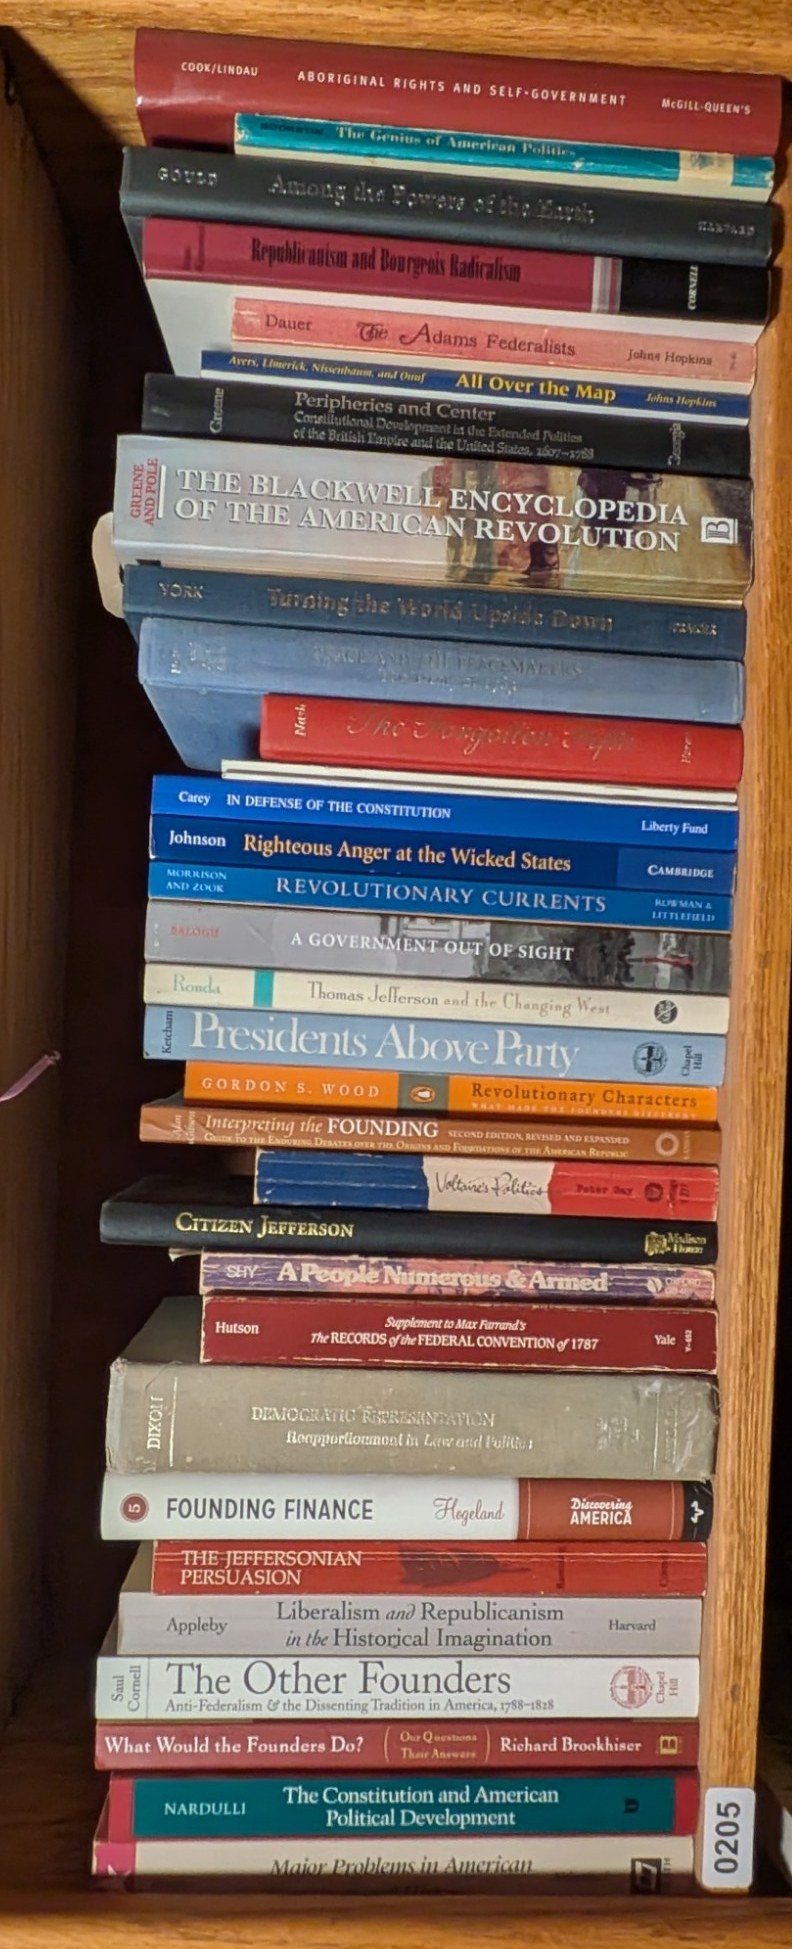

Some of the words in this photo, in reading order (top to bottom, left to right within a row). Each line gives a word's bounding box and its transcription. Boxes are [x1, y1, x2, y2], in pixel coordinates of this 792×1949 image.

[181, 62, 258, 76] COOK/LINDAU
[298, 70, 385, 88] ABORIGINAL
[393, 78, 445, 92] RIGHTS
[453, 83, 481, 96] AND
[490, 85, 626, 106] SELF-GOVERNMENT
[662, 98, 751, 115] McGILL-QUEEN'S
[251, 237, 347, 268] Republicanism
[352, 247, 376, 270] and
[380, 248, 445, 278] Bourgeois
[450, 255, 520, 282] Radicalism
[688, 265, 699, 310] CORNELL
[265, 314, 312, 331] Dauer
[357, 321, 388, 341] The
[399, 323, 477, 349] Adams
[487, 334, 576, 356] Federalists
[627, 349, 660, 362] Johns
[665, 351, 712, 366] Hopkins
[456, 373, 483, 388] All
[490, 376, 535, 392] Over
[539, 379, 569, 396] the
[575, 381, 616, 404] Map
[209, 388, 224, 433] Greene
[294, 391, 393, 414] Peripheries
[398, 401, 431, 416] and
[437, 404, 496, 421] Center
[146, 458, 158, 499] POLE
[130, 464, 144, 519] GREENE
[175, 469, 240, 494] THE
[248, 474, 441, 509] BLACKWELL
[450, 488, 689, 526] ENCYCLOPEDIA
[144, 499, 156, 526] AND
[175, 498, 216, 520] OF
[225, 501, 291, 526] THE
[299, 506, 464, 538] AMERICAN
[474, 519, 680, 552] REVOLUTION
[159, 582, 204, 599] YORK
[294, 703, 306, 736] Nash
[178, 791, 210, 805] Carey
[226, 794, 241, 806] IN
[245, 796, 303, 810] DEFENSE
[306, 799, 324, 811] OF
[327, 800, 353, 813] THE
[357, 802, 451, 819] CONSTITUTION
[641, 820, 680, 835] Liberty
[682, 823, 708, 835] Fund
[169, 830, 226, 847] Johnson
[244, 833, 333, 858] Righteous
[337, 841, 391, 863] Anger
[395, 846, 412, 861] at
[418, 844, 445, 863] the
[451, 847, 516, 868] Wicked
[521, 852, 572, 871] States
[167, 868, 227, 880] MORRISON
[648, 864, 714, 879] CAMBRIDGE
[166, 881, 189, 891] AND
[192, 882, 224, 893] ZOOK
[276, 877, 474, 904] REVOLUTIONARY
[482, 889, 607, 912] CURRENTS
[291, 933, 302, 946] A
[309, 933, 439, 954] GOVERNMENT
[444, 939, 484, 956] OUT
[489, 942, 513, 958] OF
[518, 945, 575, 961] SIGHT
[173, 974, 222, 995] Ronda
[161, 1010, 174, 1054] Ketcham
[189, 1011, 368, 1058] Presidents
[375, 1022, 490, 1065] Above
[492, 1029, 580, 1078] Party
[681, 1045, 693, 1077] Chapel
[202, 1078, 288, 1093] GORDON
[297, 1083, 313, 1095] S.
[322, 1084, 380, 1098] WOOD
[472, 1082, 595, 1105] Revolutionary
[603, 1089, 697, 1108] Characters
[205, 1114, 296, 1135] Interpreting
[300, 1115, 322, 1133] the
[327, 1117, 438, 1138] FOUNDING
[449, 1129, 483, 1139] SECOND
[525, 1132, 561, 1142] REVISED
[563, 1133, 582, 1142] AND
[584, 1134, 630, 1144] EXPANDED
[435, 1171, 489, 1194] Voltaire's
[491, 1172, 543, 1198] Politics
[175, 1212, 252, 1233] CITIZEN
[257, 1214, 354, 1238] JEFFERSON
[226, 1265, 259, 1279] SHY
[276, 1263, 297, 1282] A
[300, 1263, 380, 1286] People
[383, 1265, 501, 1289] Numerous
[505, 1270, 526, 1289] &
[529, 1271, 608, 1291] Armed
[215, 1321, 260, 1335] Hutson
[385, 1316, 442, 1331] Supplement
[444, 1319, 454, 1329] to
[455, 1319, 478, 1330] Max
[479, 1320, 526, 1331] Farrand's
[311, 1332, 329, 1345] The
[331, 1332, 387, 1346] RECORDS
[389, 1333, 400, 1347] of
[401, 1334, 416, 1346] the
[418, 1334, 475, 1348] FEDERAL
[477, 1335, 555, 1349] CONVENTION
[556, 1337, 569, 1352] of
[571, 1338, 599, 1350] 1787
[655, 1334, 676, 1345] Yale
[128, 1503, 141, 1513] 5
[166, 1497, 276, 1520] FOUNDING
[284, 1498, 374, 1520] FINANCE
[433, 1497, 505, 1521] Hogeland
[570, 1496, 633, 1511] Discovering
[570, 1510, 633, 1525] AMERICA
[181, 1550, 218, 1566] THE
[224, 1551, 362, 1569] JEFFERSONIAN
[180, 1569, 302, 1585] PERSUASION
[276, 1600, 380, 1620] Liberalism
[386, 1602, 416, 1620] and
[421, 1601, 564, 1625] Republicanism
[166, 1617, 228, 1634] Appleby
[608, 1619, 656, 1632] Harvard
[286, 1631, 301, 1647] in
[306, 1628, 328, 1647] the
[333, 1628, 428, 1648] Historical
[437, 1628, 552, 1652] Imagination
[111, 1674, 125, 1701] Saul
[127, 1665, 141, 1712] Cornell
[166, 1660, 231, 1694] The
[243, 1660, 347, 1694] Other
[358, 1660, 511, 1694] Founders
[655, 1671, 666, 1704] Chapel
[669, 1677, 679, 1697] Hill
[104, 1735, 151, 1754] What
[156, 1735, 209, 1753] Would
[215, 1735, 241, 1753] the
[246, 1735, 326, 1753] Founders
[331, 1735, 364, 1753] Do?
[500, 1736, 557, 1752] Richard
[561, 1736, 642, 1753] Brookhiser
[283, 1786, 318, 1804] The
[322, 1786, 434, 1804] Constitution
[438, 1786, 468, 1804] and
[475, 1786, 559, 1804] American
[163, 1802, 246, 1816] NARDULLI
[326, 1808, 395, 1827] Political
[400, 1809, 515, 1829] Development
[714, 1802, 741, 1874] 0205
[271, 1859, 326, 1875] Major
[331, 1858, 414, 1875] Problems
[420, 1857, 440, 1874] in
[444, 1856, 533, 1874] American
